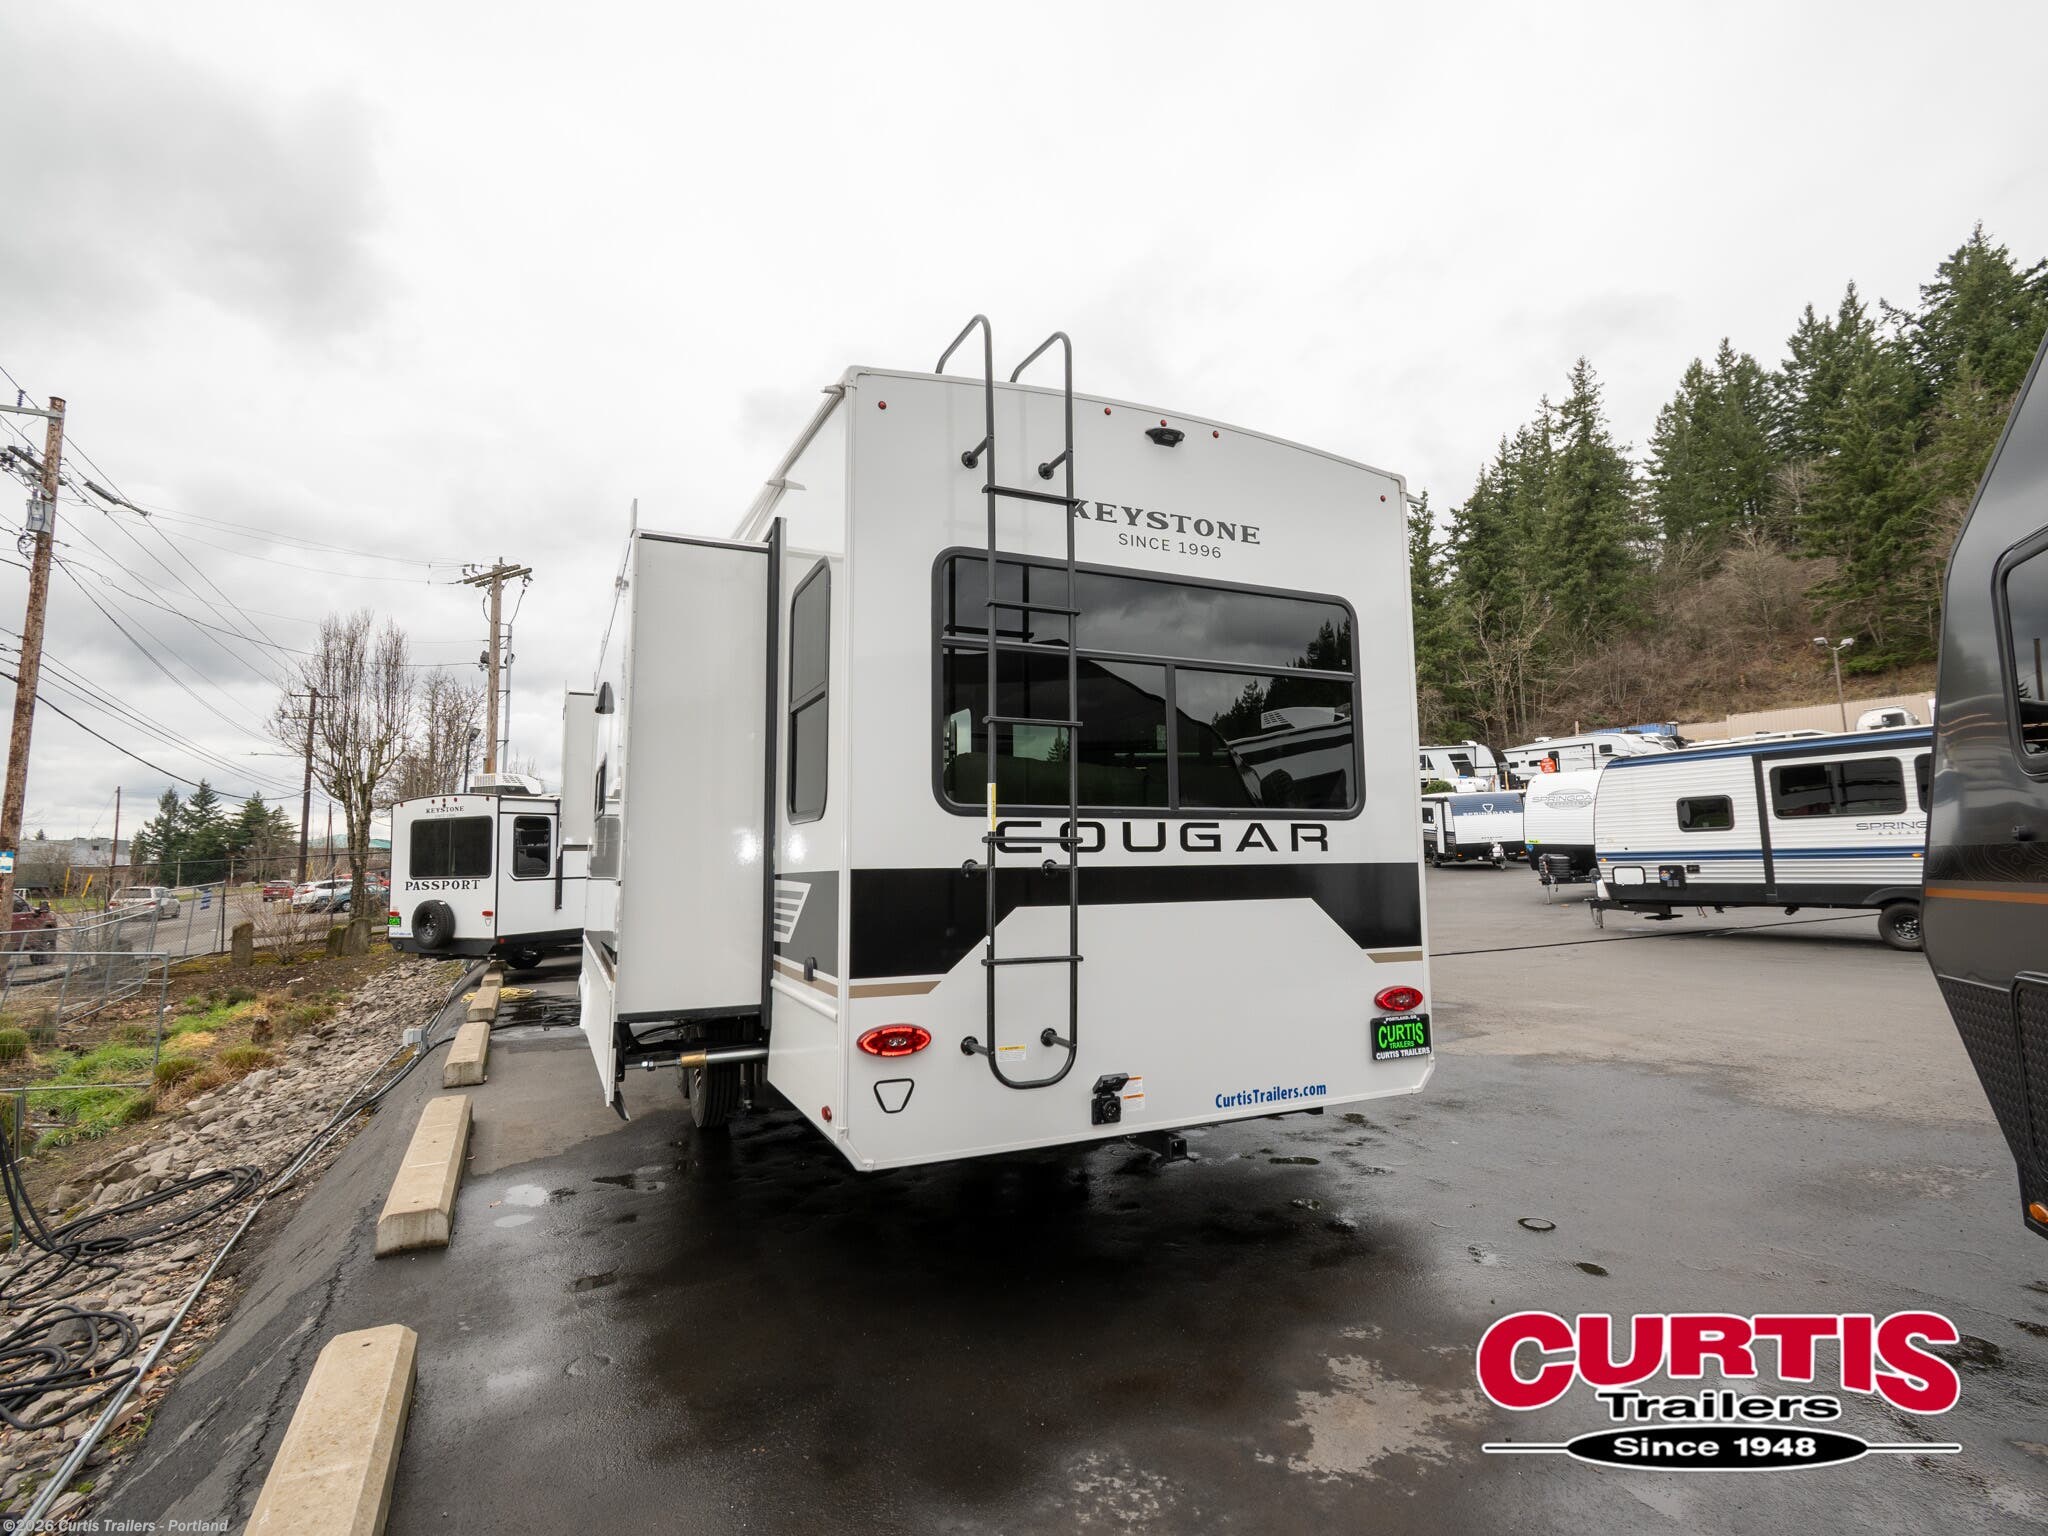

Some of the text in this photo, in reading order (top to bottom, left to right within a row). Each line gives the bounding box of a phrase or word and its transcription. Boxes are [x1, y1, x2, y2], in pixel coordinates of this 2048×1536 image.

[1073, 499, 1261, 545] KEYSTONE
[1118, 532, 1222, 559] SINCE 1996
[426, 805, 465, 814] KEYSTONE
[995, 821, 1329, 853] COUGAR
[405, 879, 481, 891] PASSPORT
[1378, 1022, 1425, 1048] CURTIS
[1389, 1040, 1415, 1049] TRAILERS
[1376, 1047, 1430, 1060] CURTIS TRAILERS
[1215, 1084, 1327, 1108] CurtisTrailers.com
